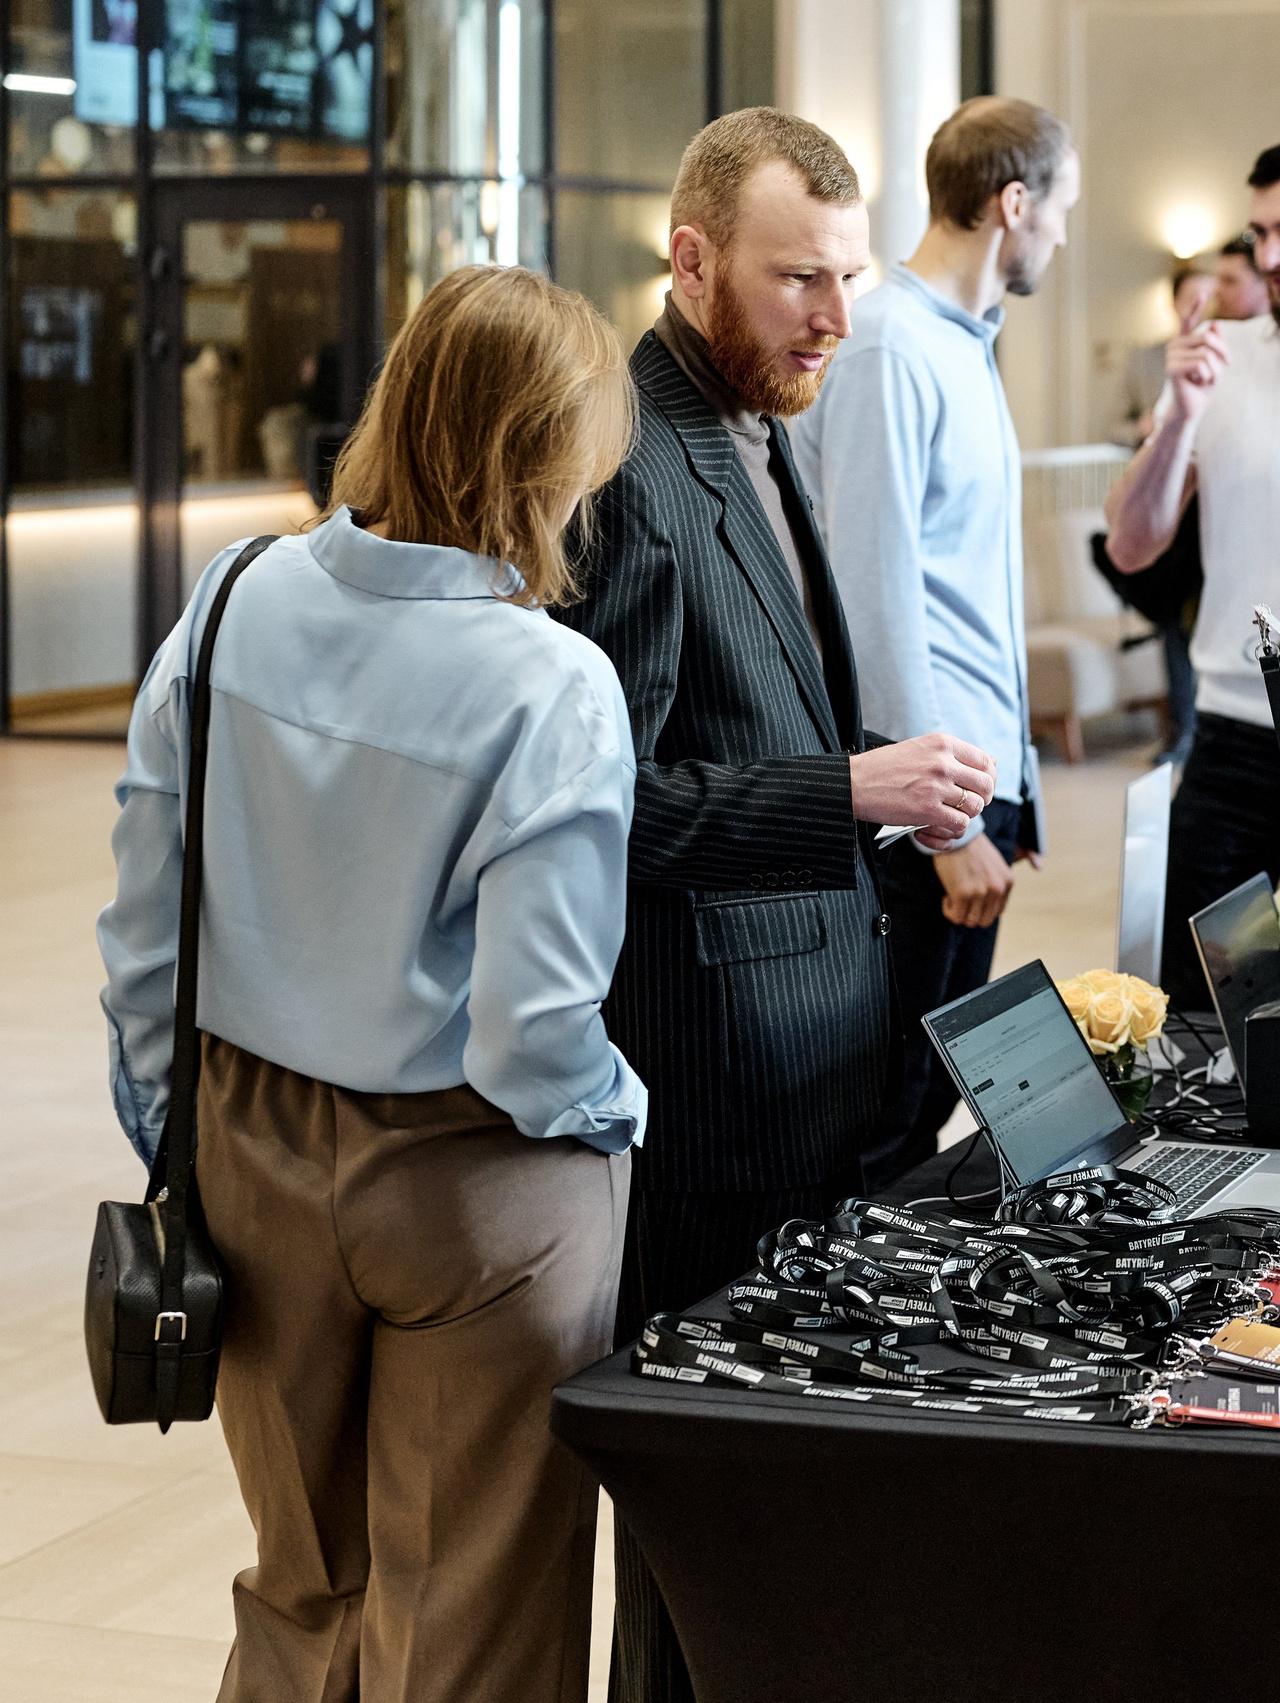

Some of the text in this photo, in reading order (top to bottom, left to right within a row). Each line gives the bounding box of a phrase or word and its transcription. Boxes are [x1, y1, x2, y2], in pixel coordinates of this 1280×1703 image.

[1072, 1168, 1102, 1185] BATYREV
[1146, 1181, 1172, 1200] BATYREV
[892, 1216, 927, 1234] BATYREV
[1128, 1235, 1161, 1250] BATYREV
[904, 1261, 939, 1274] BATYREV
[979, 1248, 1011, 1274] BATYREV
[1116, 1257, 1151, 1268] BATYREV
[744, 1286, 778, 1300] BATYREV
[990, 1324, 1021, 1342] BATYREV
[1075, 1329, 1102, 1342] BATYREV
[700, 1340, 737, 1354] BATYREV
[786, 1338, 819, 1358] BATYREV
[642, 1362, 679, 1379] BATYREV
[696, 1353, 736, 1374] BATYREV
[1039, 1372, 1078, 1382] BATYREV
[1060, 1383, 1099, 1398] BATYREV
